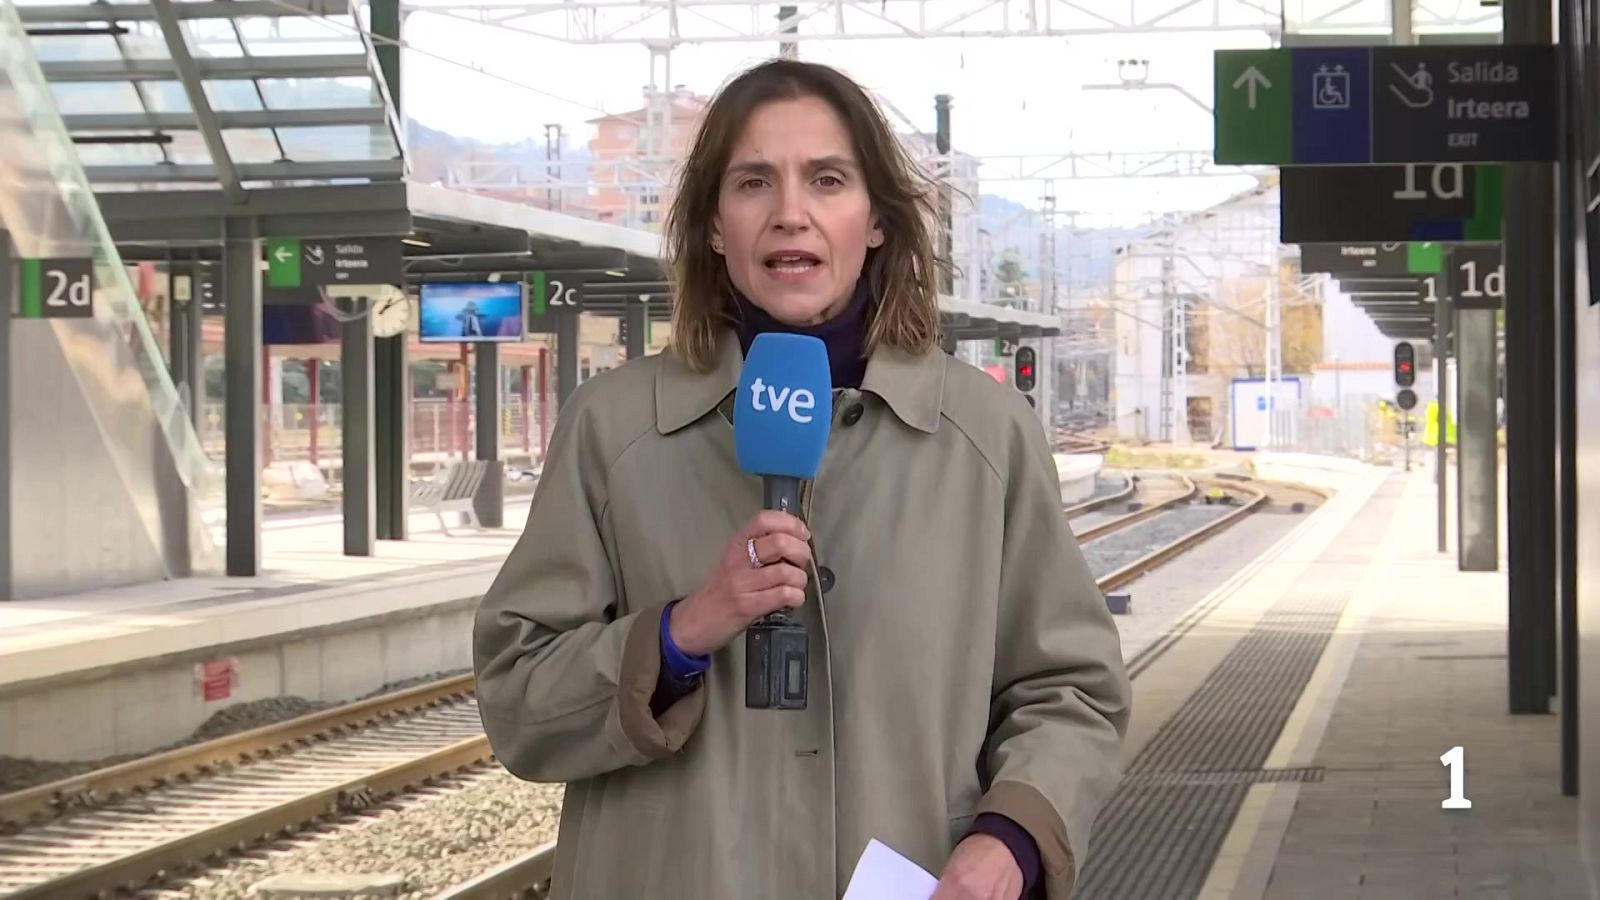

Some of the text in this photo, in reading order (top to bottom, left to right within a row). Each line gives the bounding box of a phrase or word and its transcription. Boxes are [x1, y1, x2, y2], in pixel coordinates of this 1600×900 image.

[1447, 61, 1518, 83] Salida
[1447, 98, 1530, 118] Irteera
[1447, 132, 1478, 147] EXIT
[1393, 163, 1463, 199] 1d
[46, 270, 90, 306] 2d
[1423, 276, 1439, 302] 1
[1459, 261, 1505, 297] 1d
[549, 280, 577, 305] 2c
[750, 377, 815, 423] tve
